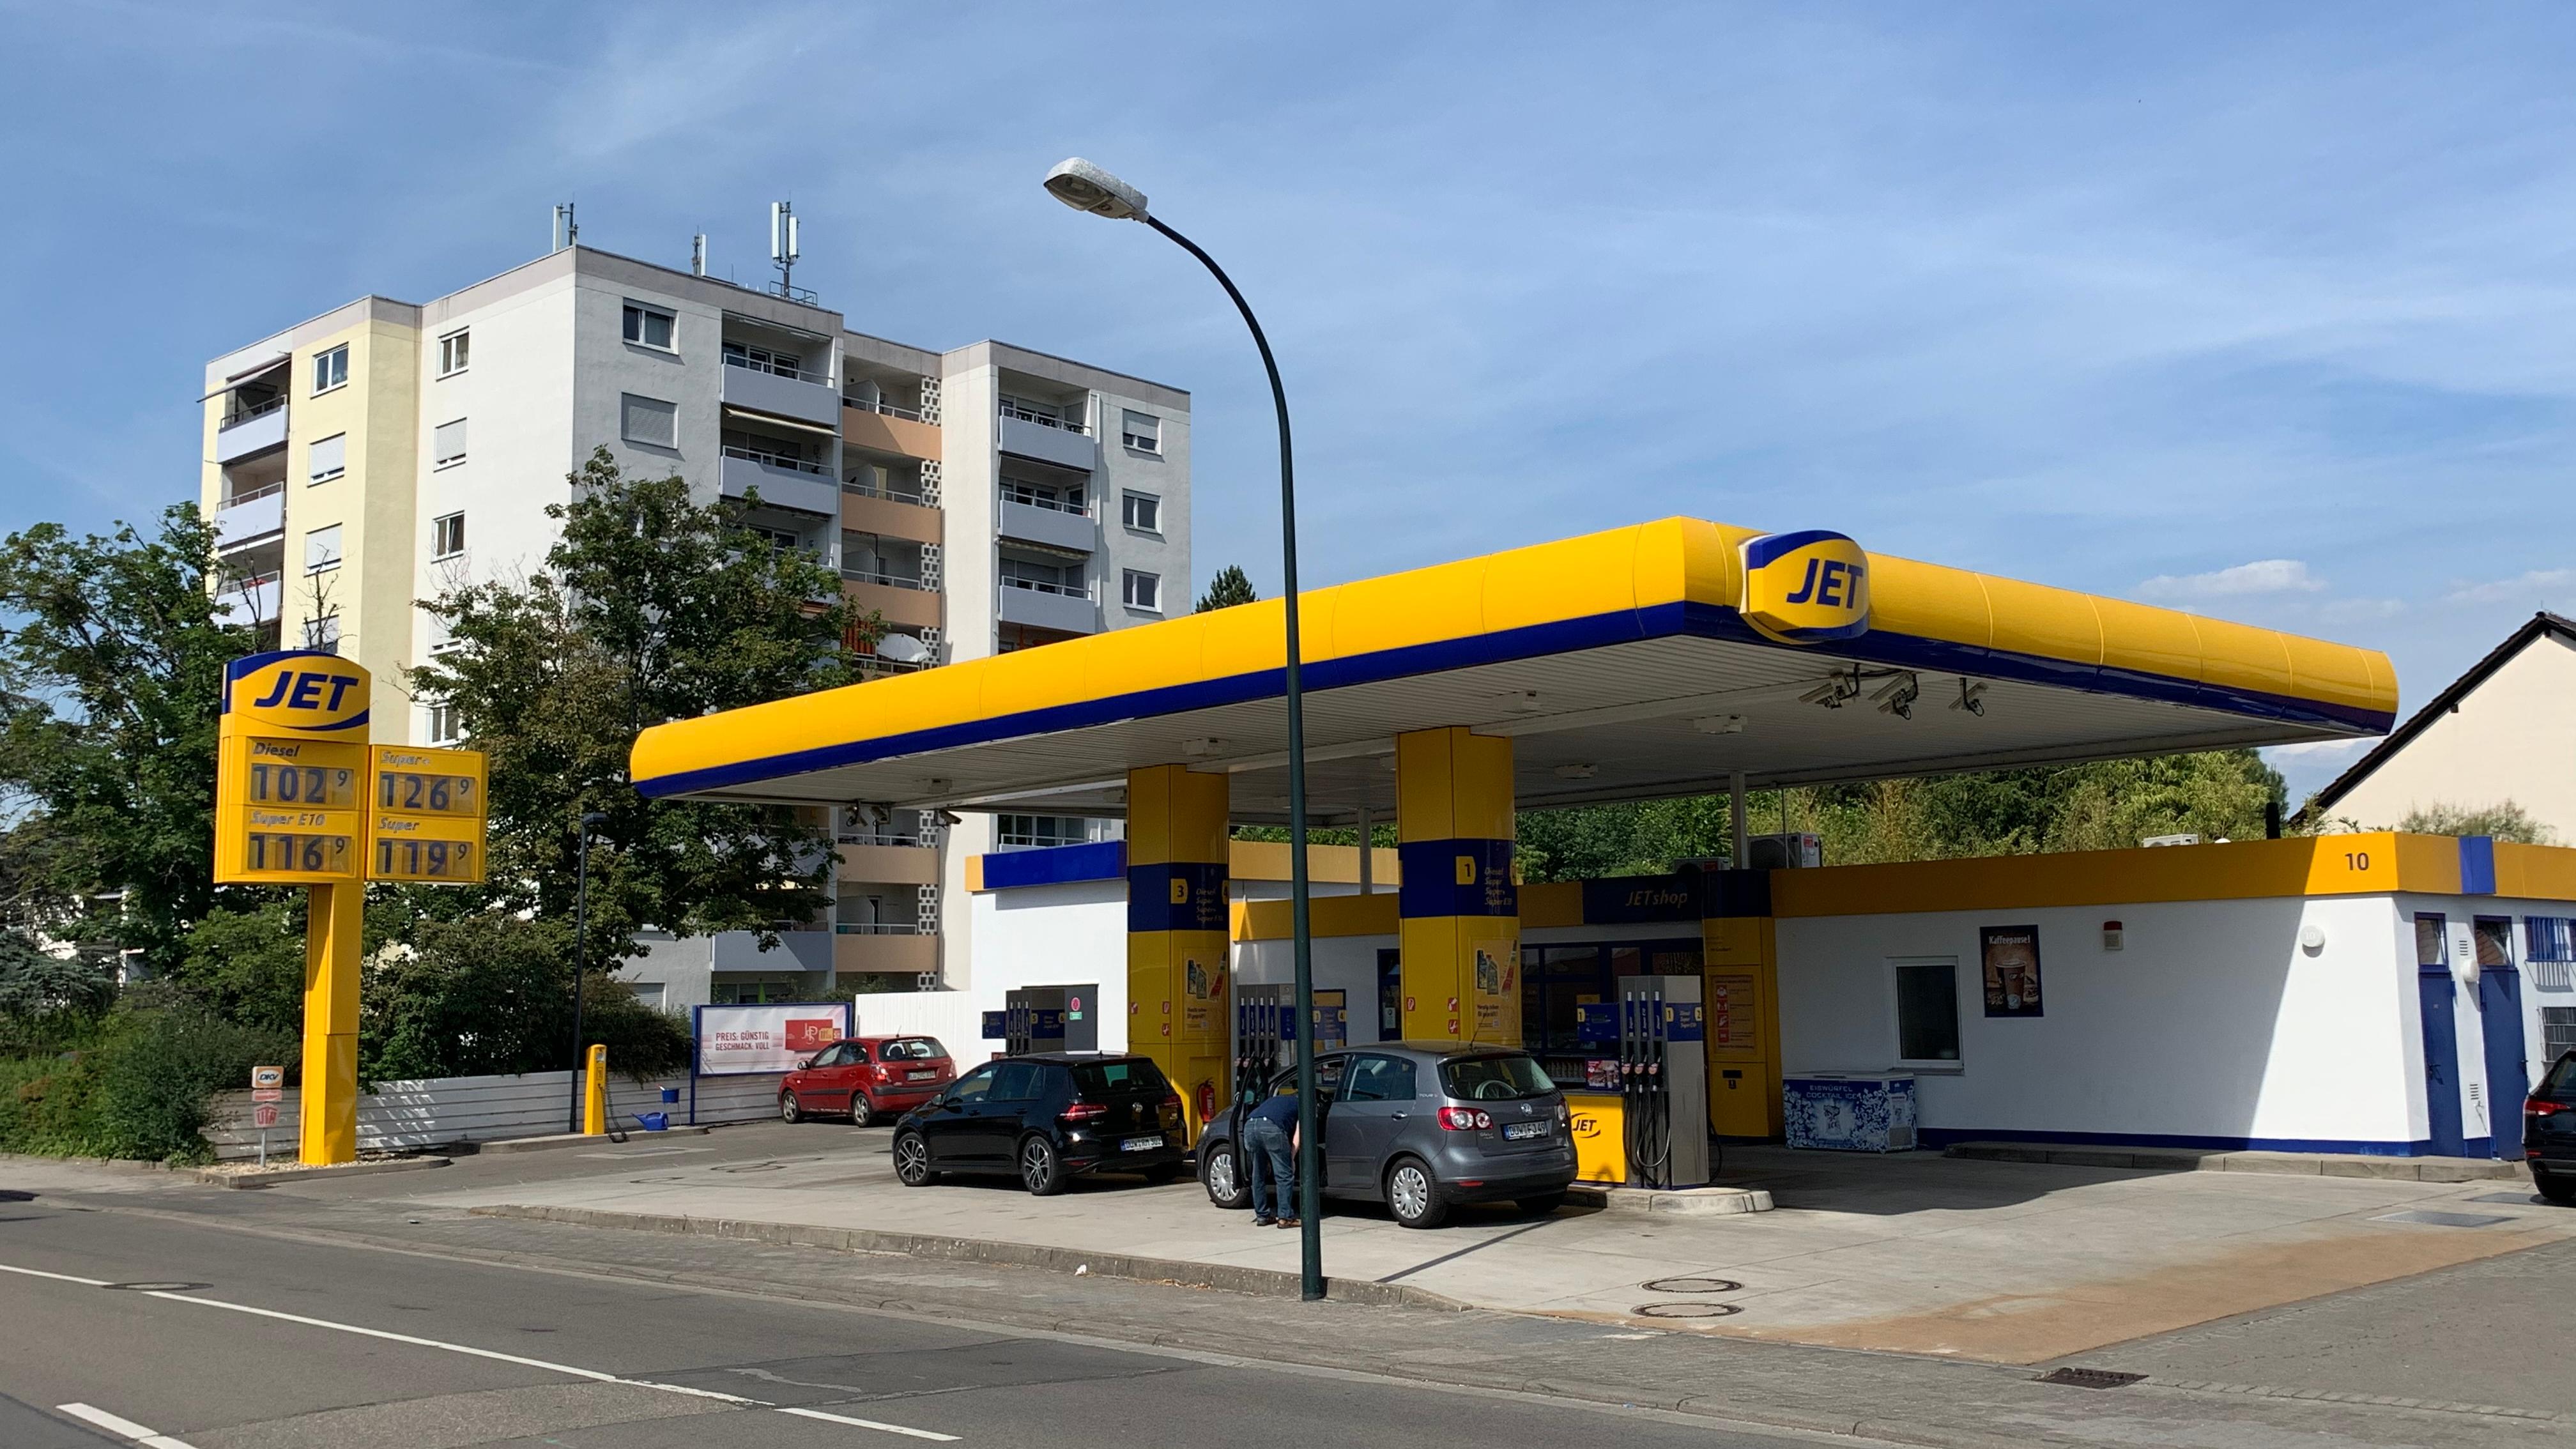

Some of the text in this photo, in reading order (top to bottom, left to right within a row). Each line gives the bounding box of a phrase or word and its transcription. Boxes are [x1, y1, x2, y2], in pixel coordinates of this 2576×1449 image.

[1786, 558, 1864, 609] JET
[253, 670, 359, 712] JET
[253, 742, 301, 758] Diesel
[253, 765, 348, 804] 102 9
[381, 773, 470, 810] 126 9
[250, 811, 325, 827] Super E10
[378, 816, 420, 834] Super
[250, 834, 345, 871] 116 9
[379, 840, 468, 875] 119 9
[2345, 852, 2370, 871] 10
[1464, 863, 1471, 877] 1
[1177, 885, 1184, 898] 3
[1988, 935, 2031, 946] Kaffeepause!
[1578, 1011, 1583, 1021] 1
[1667, 1010, 1671, 1020] 1
[716, 1030, 769, 1041] PREIS: GÜNSTIG
[756, 1041, 770, 1050] VOLL
[1809, 1084, 1853, 1092] EISWÜRFEL
[257, 1108, 277, 1125] UTA
[1572, 1119, 1597, 1132] JET
